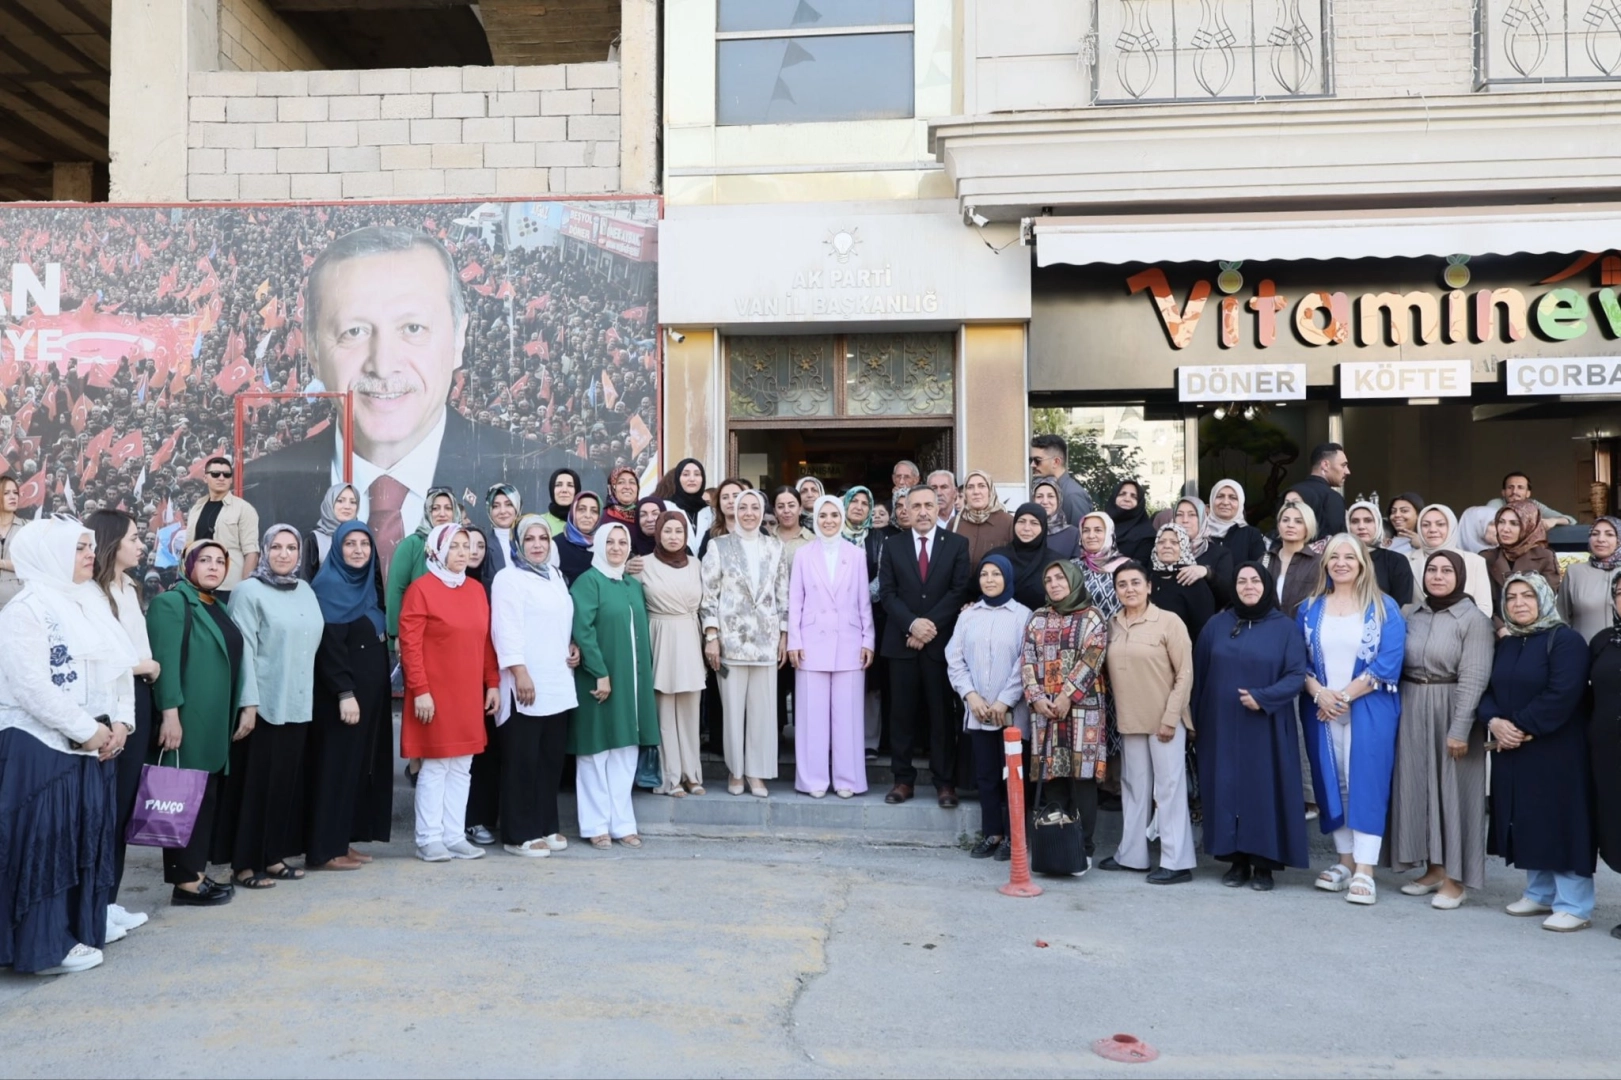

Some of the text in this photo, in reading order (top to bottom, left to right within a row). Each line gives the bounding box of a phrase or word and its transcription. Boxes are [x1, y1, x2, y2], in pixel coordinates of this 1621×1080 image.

[0, 262, 61, 316] N
[792, 263, 892, 289] AK PARTİ
[734, 296, 779, 316] VAN
[785, 292, 805, 316] İL
[0, 329, 63, 361] YE
[1186, 364, 1296, 395] DÖNER
[1353, 362, 1458, 393] KÖFTE
